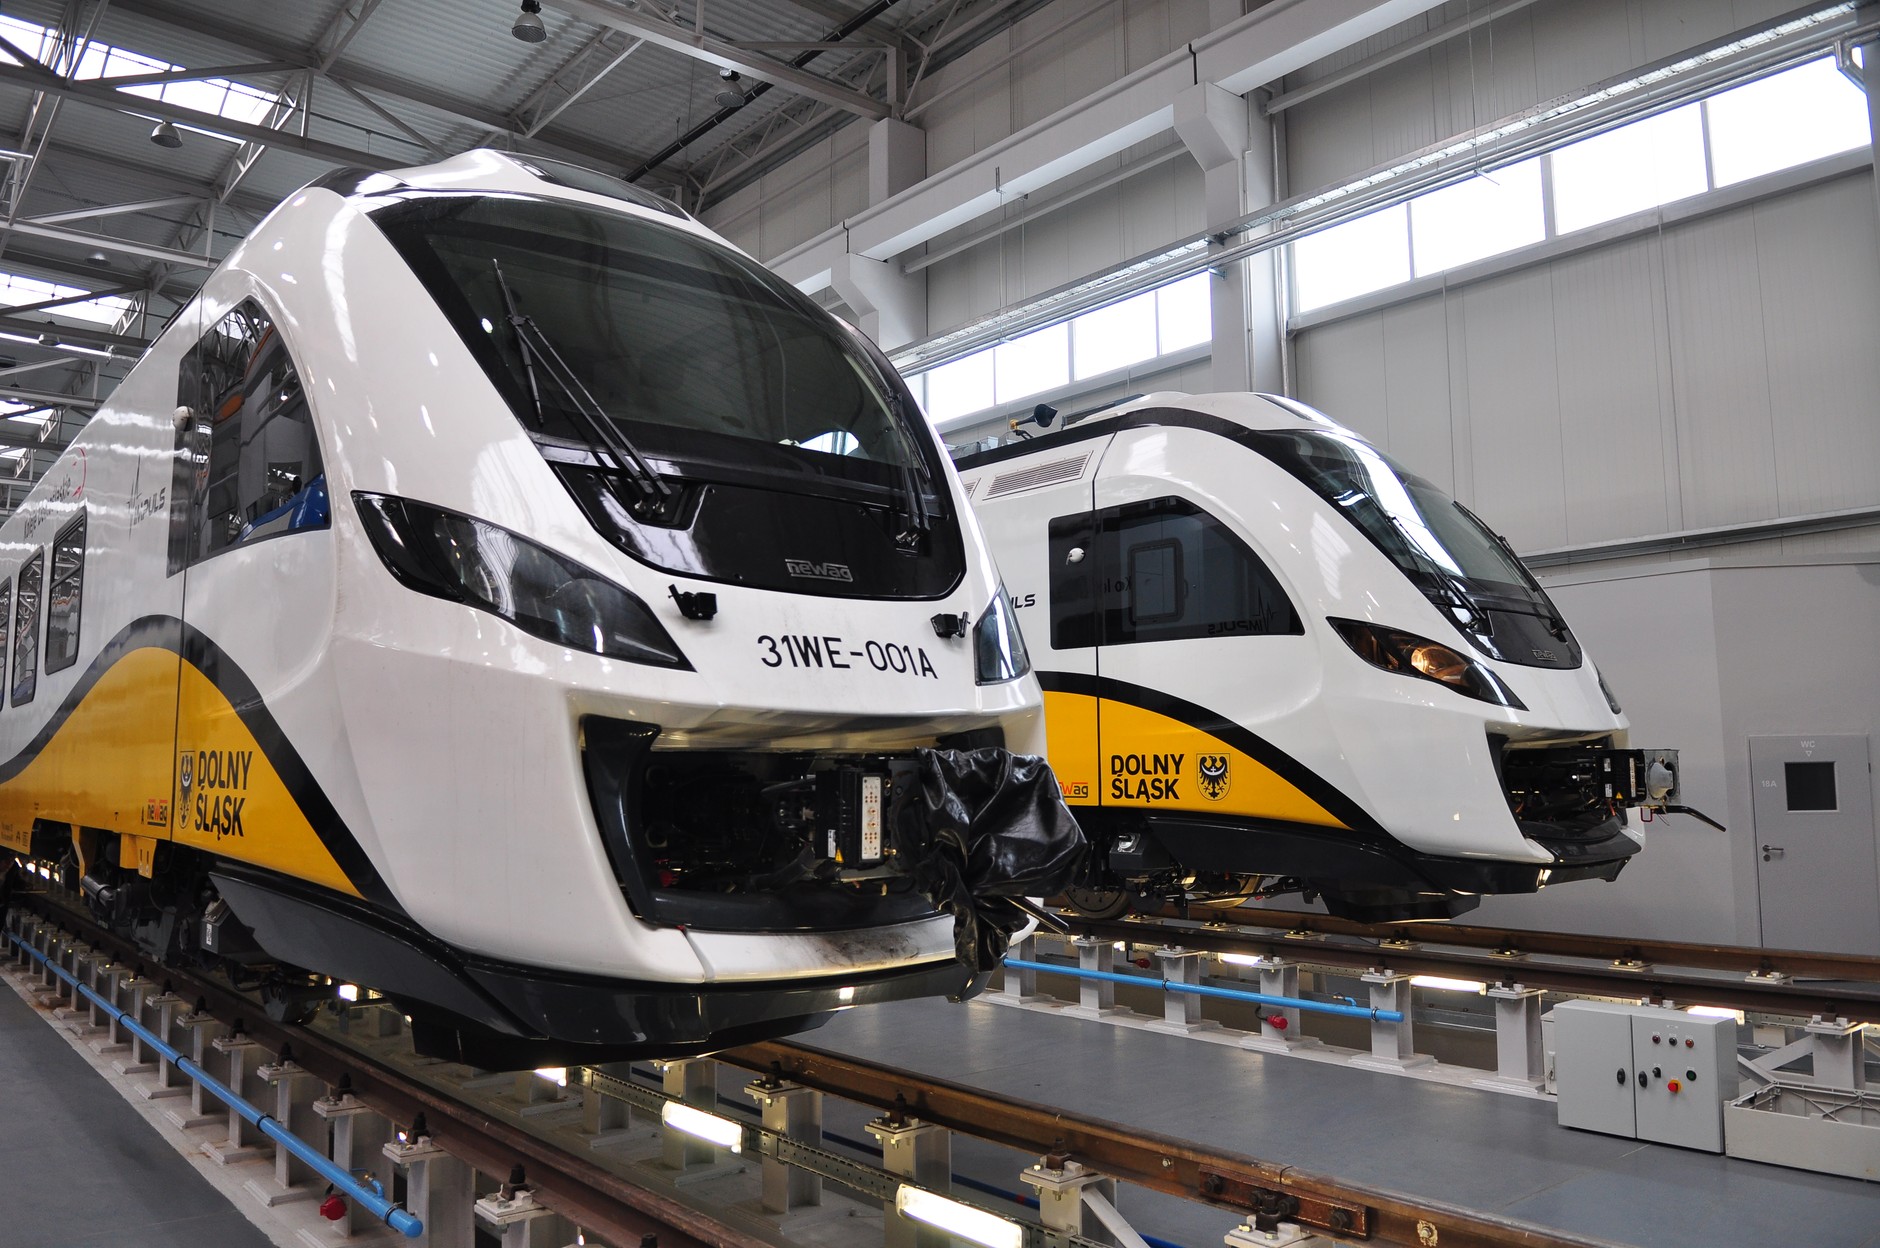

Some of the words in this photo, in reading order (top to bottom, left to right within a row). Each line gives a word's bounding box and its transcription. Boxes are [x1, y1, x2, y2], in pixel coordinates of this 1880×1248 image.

[757, 634, 939, 680] 31WE-001A
[1800, 740, 1816, 749] WC
[197, 750, 253, 791] DOLNY
[1110, 753, 1185, 775] DOLNY
[1110, 773, 1180, 803] ŚLĄSK
[194, 785, 246, 841] ŚLĄSK
